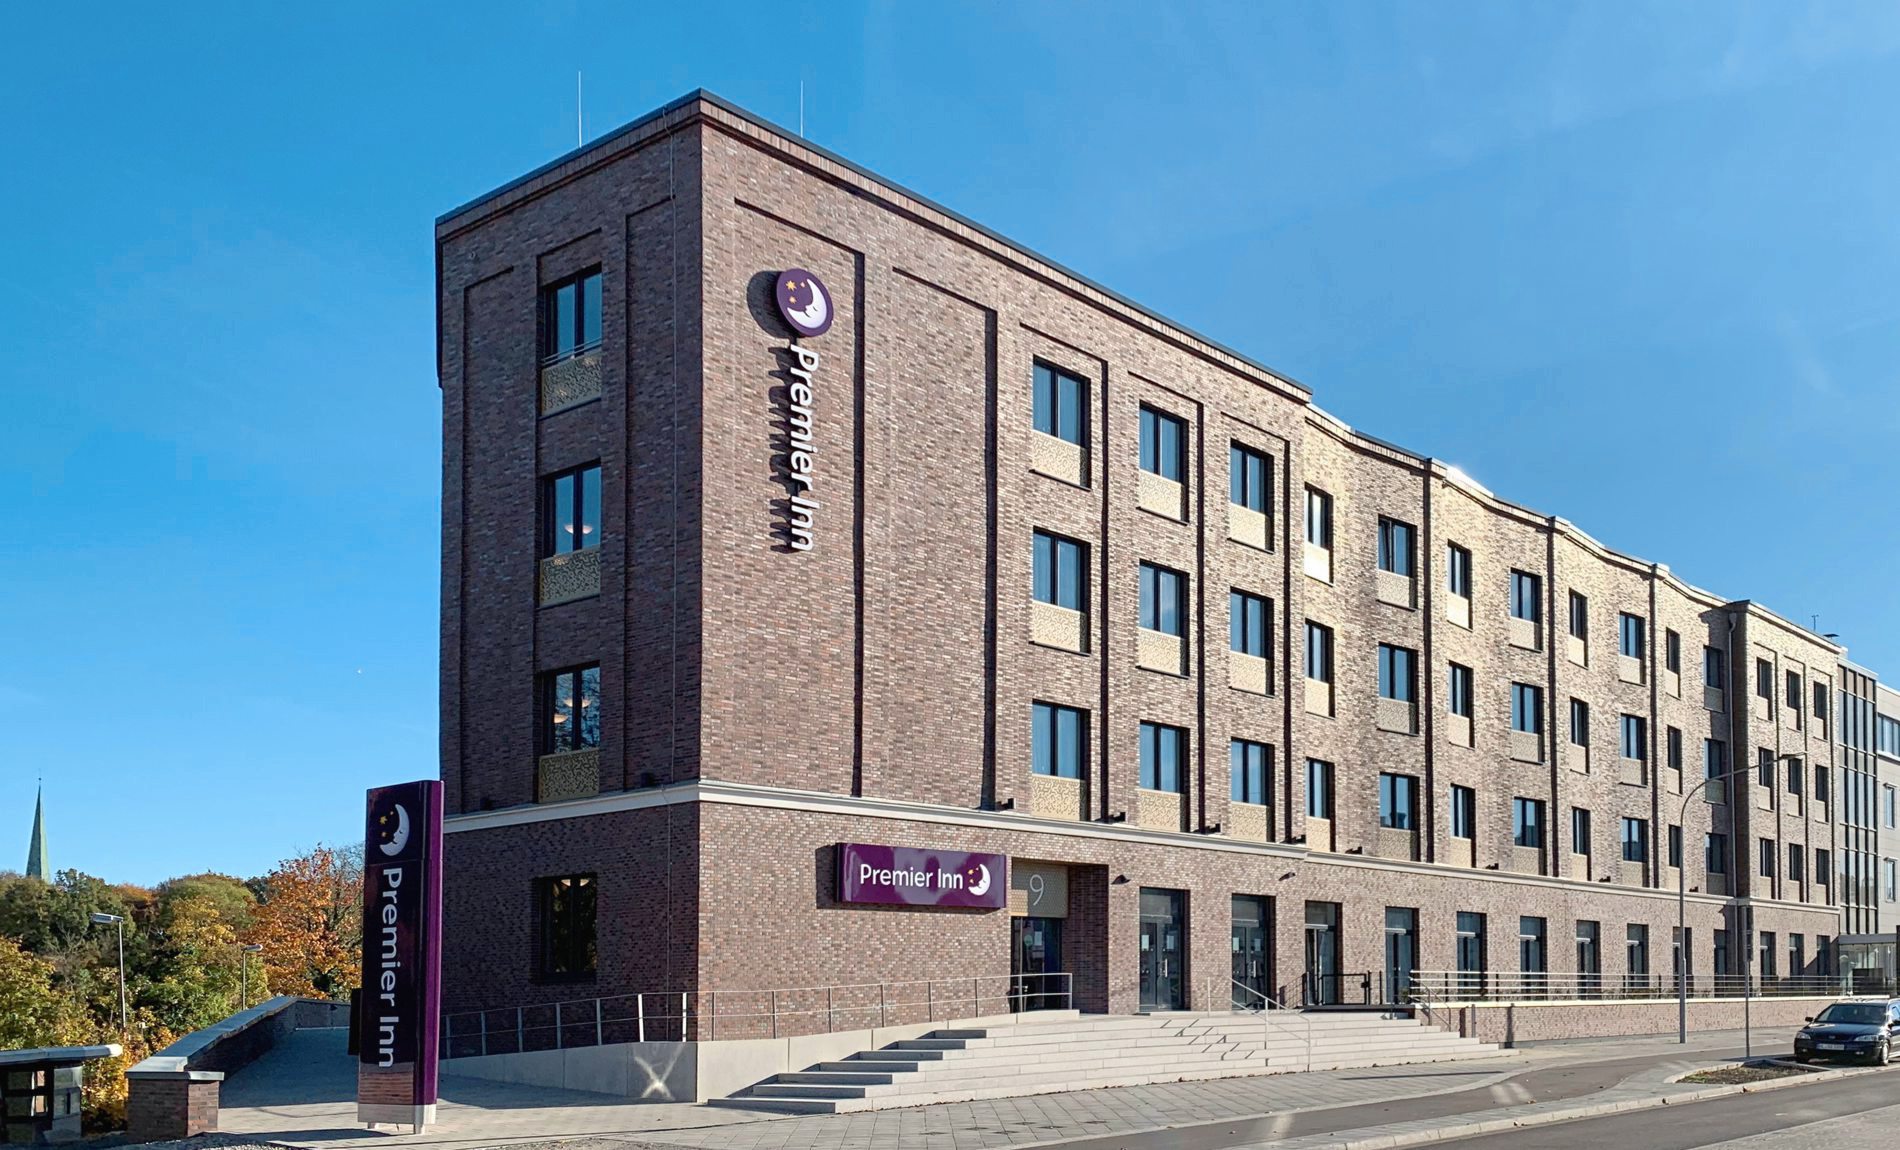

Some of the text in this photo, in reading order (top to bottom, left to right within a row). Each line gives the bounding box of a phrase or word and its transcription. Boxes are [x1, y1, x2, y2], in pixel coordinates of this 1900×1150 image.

[790, 345, 820, 551] Premier Inn
[859, 864, 963, 890] Premier Inn
[1029, 874, 1045, 906] 9
[378, 867, 402, 1068] Premier Inn
